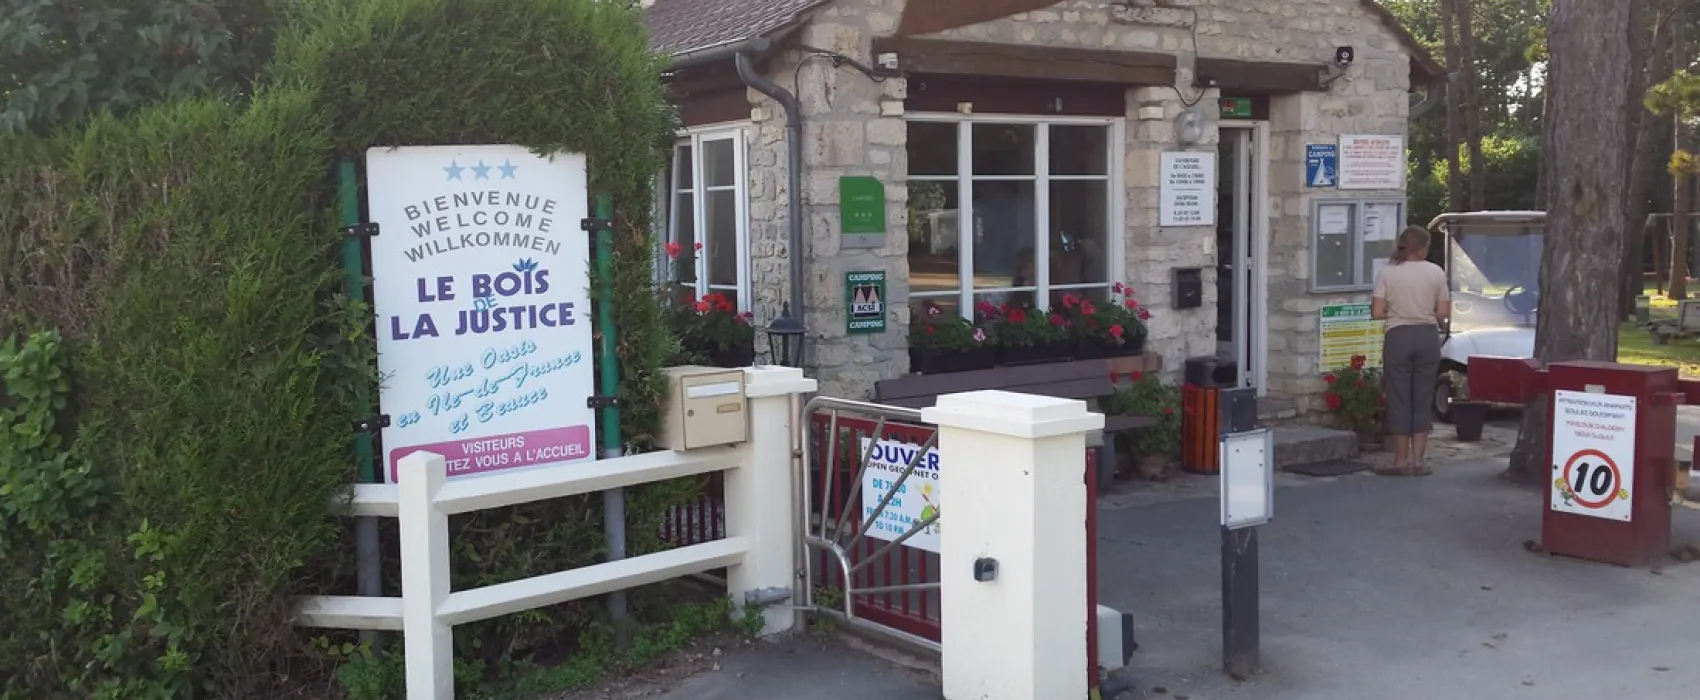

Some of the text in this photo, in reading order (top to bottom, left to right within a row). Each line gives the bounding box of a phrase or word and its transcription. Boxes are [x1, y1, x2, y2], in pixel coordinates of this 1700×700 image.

[404, 191, 557, 221] BIENVENUE
[411, 211, 553, 238] WELCOME
[404, 232, 561, 263] WILLKOMMEN
[417, 269, 549, 303] LE BOIS
[849, 273, 884, 281] CAMPING
[473, 295, 499, 312] DE
[391, 302, 576, 341] LA JUSTICE
[850, 320, 884, 329] CAMPING
[426, 340, 537, 389] Une Oasis
[396, 411, 421, 429] en
[449, 387, 548, 434] et Beauce
[462, 435, 525, 455] VISITEURS
[475, 452, 509, 468] VOUS
[513, 452, 522, 463] A
[526, 443, 585, 461] L'ACCUEIL
[872, 478, 882, 489] DE
[1575, 462, 1612, 496] 10
